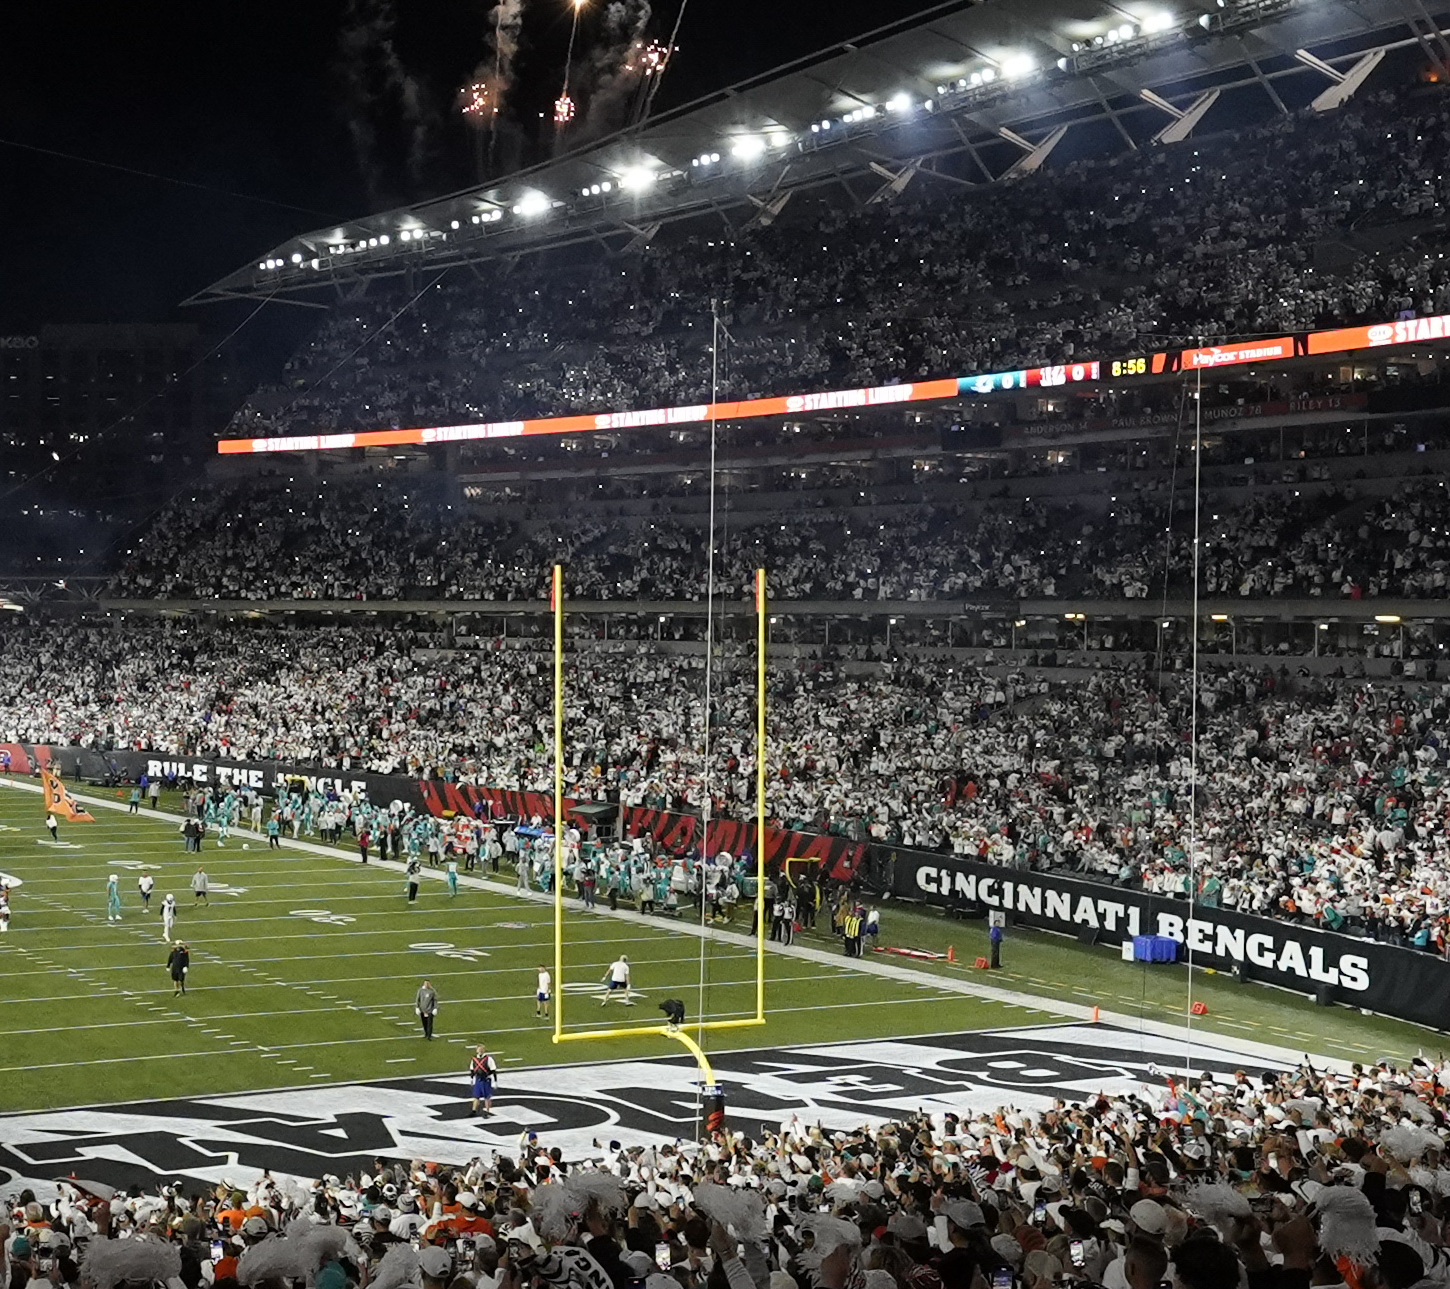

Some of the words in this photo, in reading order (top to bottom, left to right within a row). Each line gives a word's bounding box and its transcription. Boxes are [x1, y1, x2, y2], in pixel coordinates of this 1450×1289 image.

[1112, 358, 1146, 377] 8:56
[804, 389, 864, 410] STARTING
[868, 384, 912, 405] LINEUP
[1290, 399, 1323, 412] RILEY
[1141, 414, 1179, 426] BROWN
[148, 760, 207, 781] RULE
[215, 766, 264, 788] THE
[272, 773, 366, 800] JNGLE
[915, 865, 1141, 936] CINCINNATI
[1157, 912, 1370, 992] BENGALS
